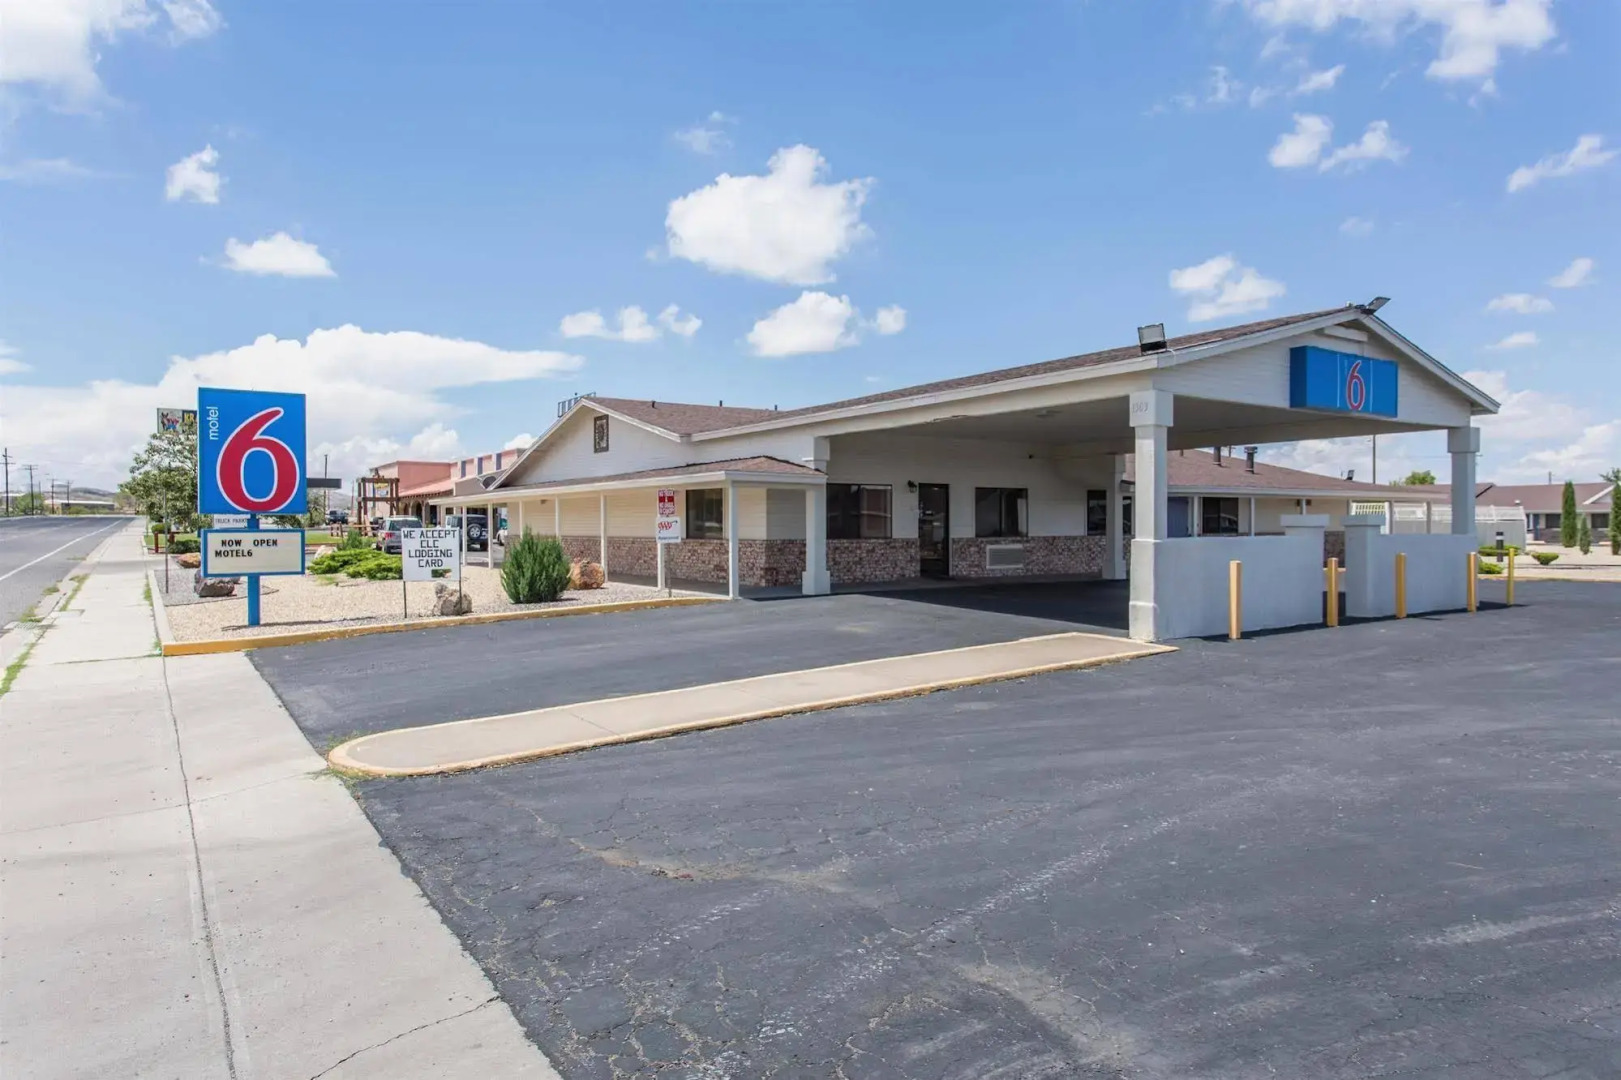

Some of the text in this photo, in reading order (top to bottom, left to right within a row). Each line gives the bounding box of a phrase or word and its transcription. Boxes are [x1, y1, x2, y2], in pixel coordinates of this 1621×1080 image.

[1346, 359, 1365, 410] 6
[206, 406, 219, 440] motel
[216, 407, 300, 512] 6
[403, 529, 457, 539] WE ACCEPT
[221, 538, 278, 548] NOW OPEN
[421, 540, 439, 548] CLC
[214, 549, 253, 558] MOTEL6
[408, 549, 453, 558] LODGING
[418, 559, 443, 567] CARD
